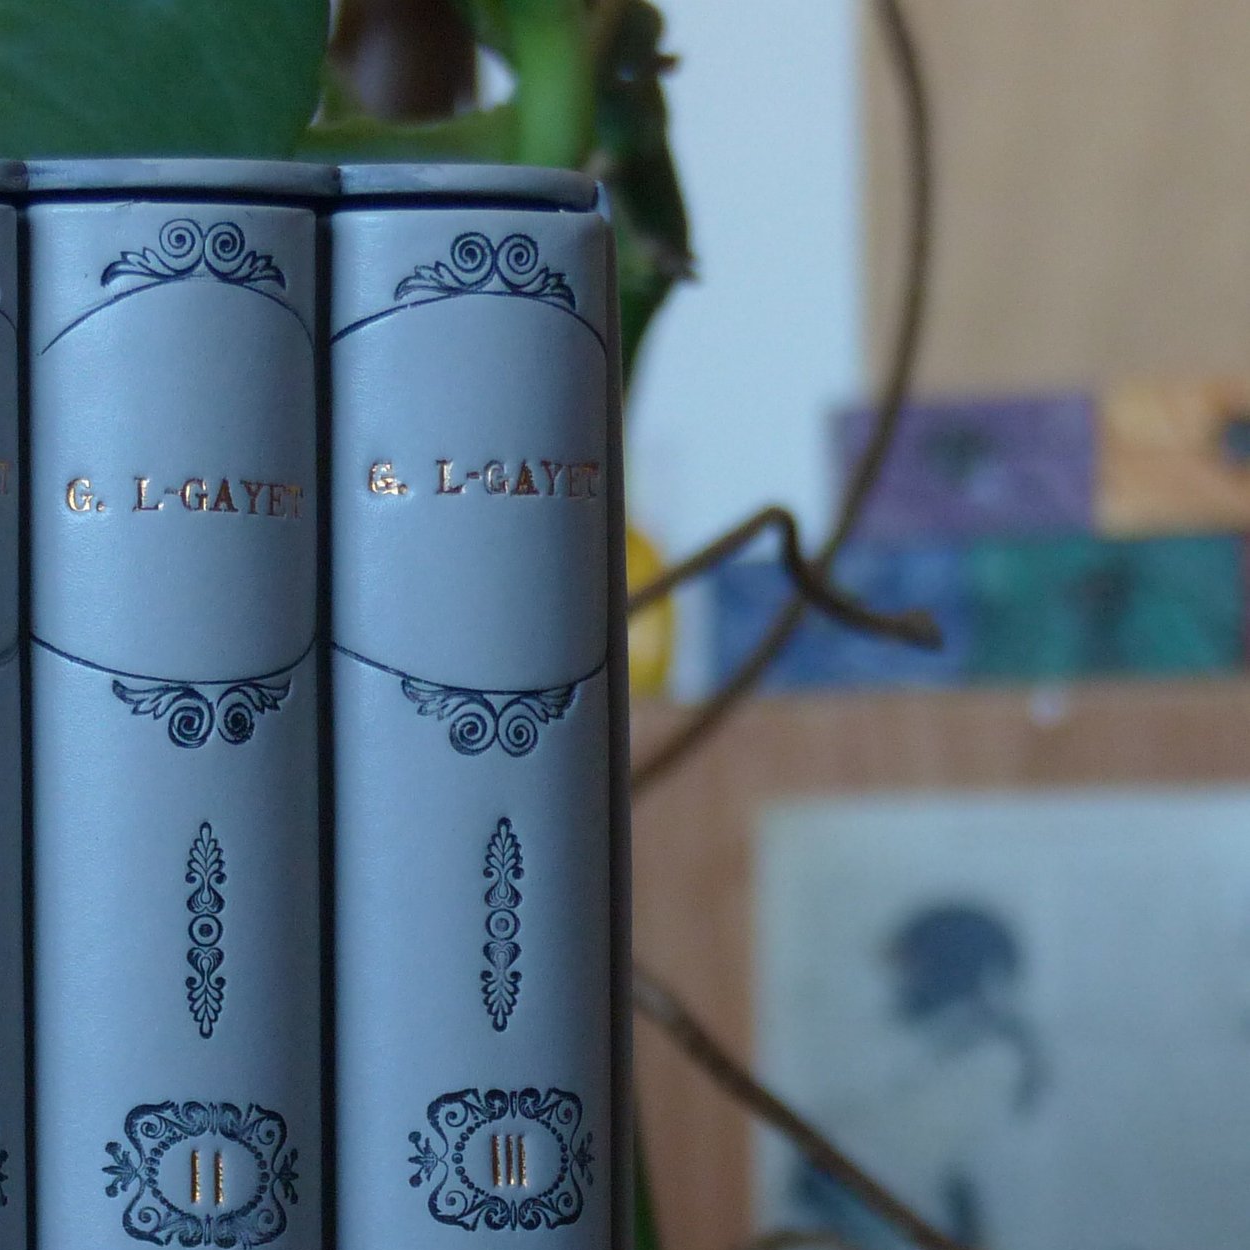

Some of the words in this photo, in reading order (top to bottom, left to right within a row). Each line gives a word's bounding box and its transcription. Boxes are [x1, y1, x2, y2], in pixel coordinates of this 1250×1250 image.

[66, 477, 106, 513] G.
[368, 461, 408, 495] G.
[191, 1149, 224, 1206] II
[491, 1133, 527, 1187] III
